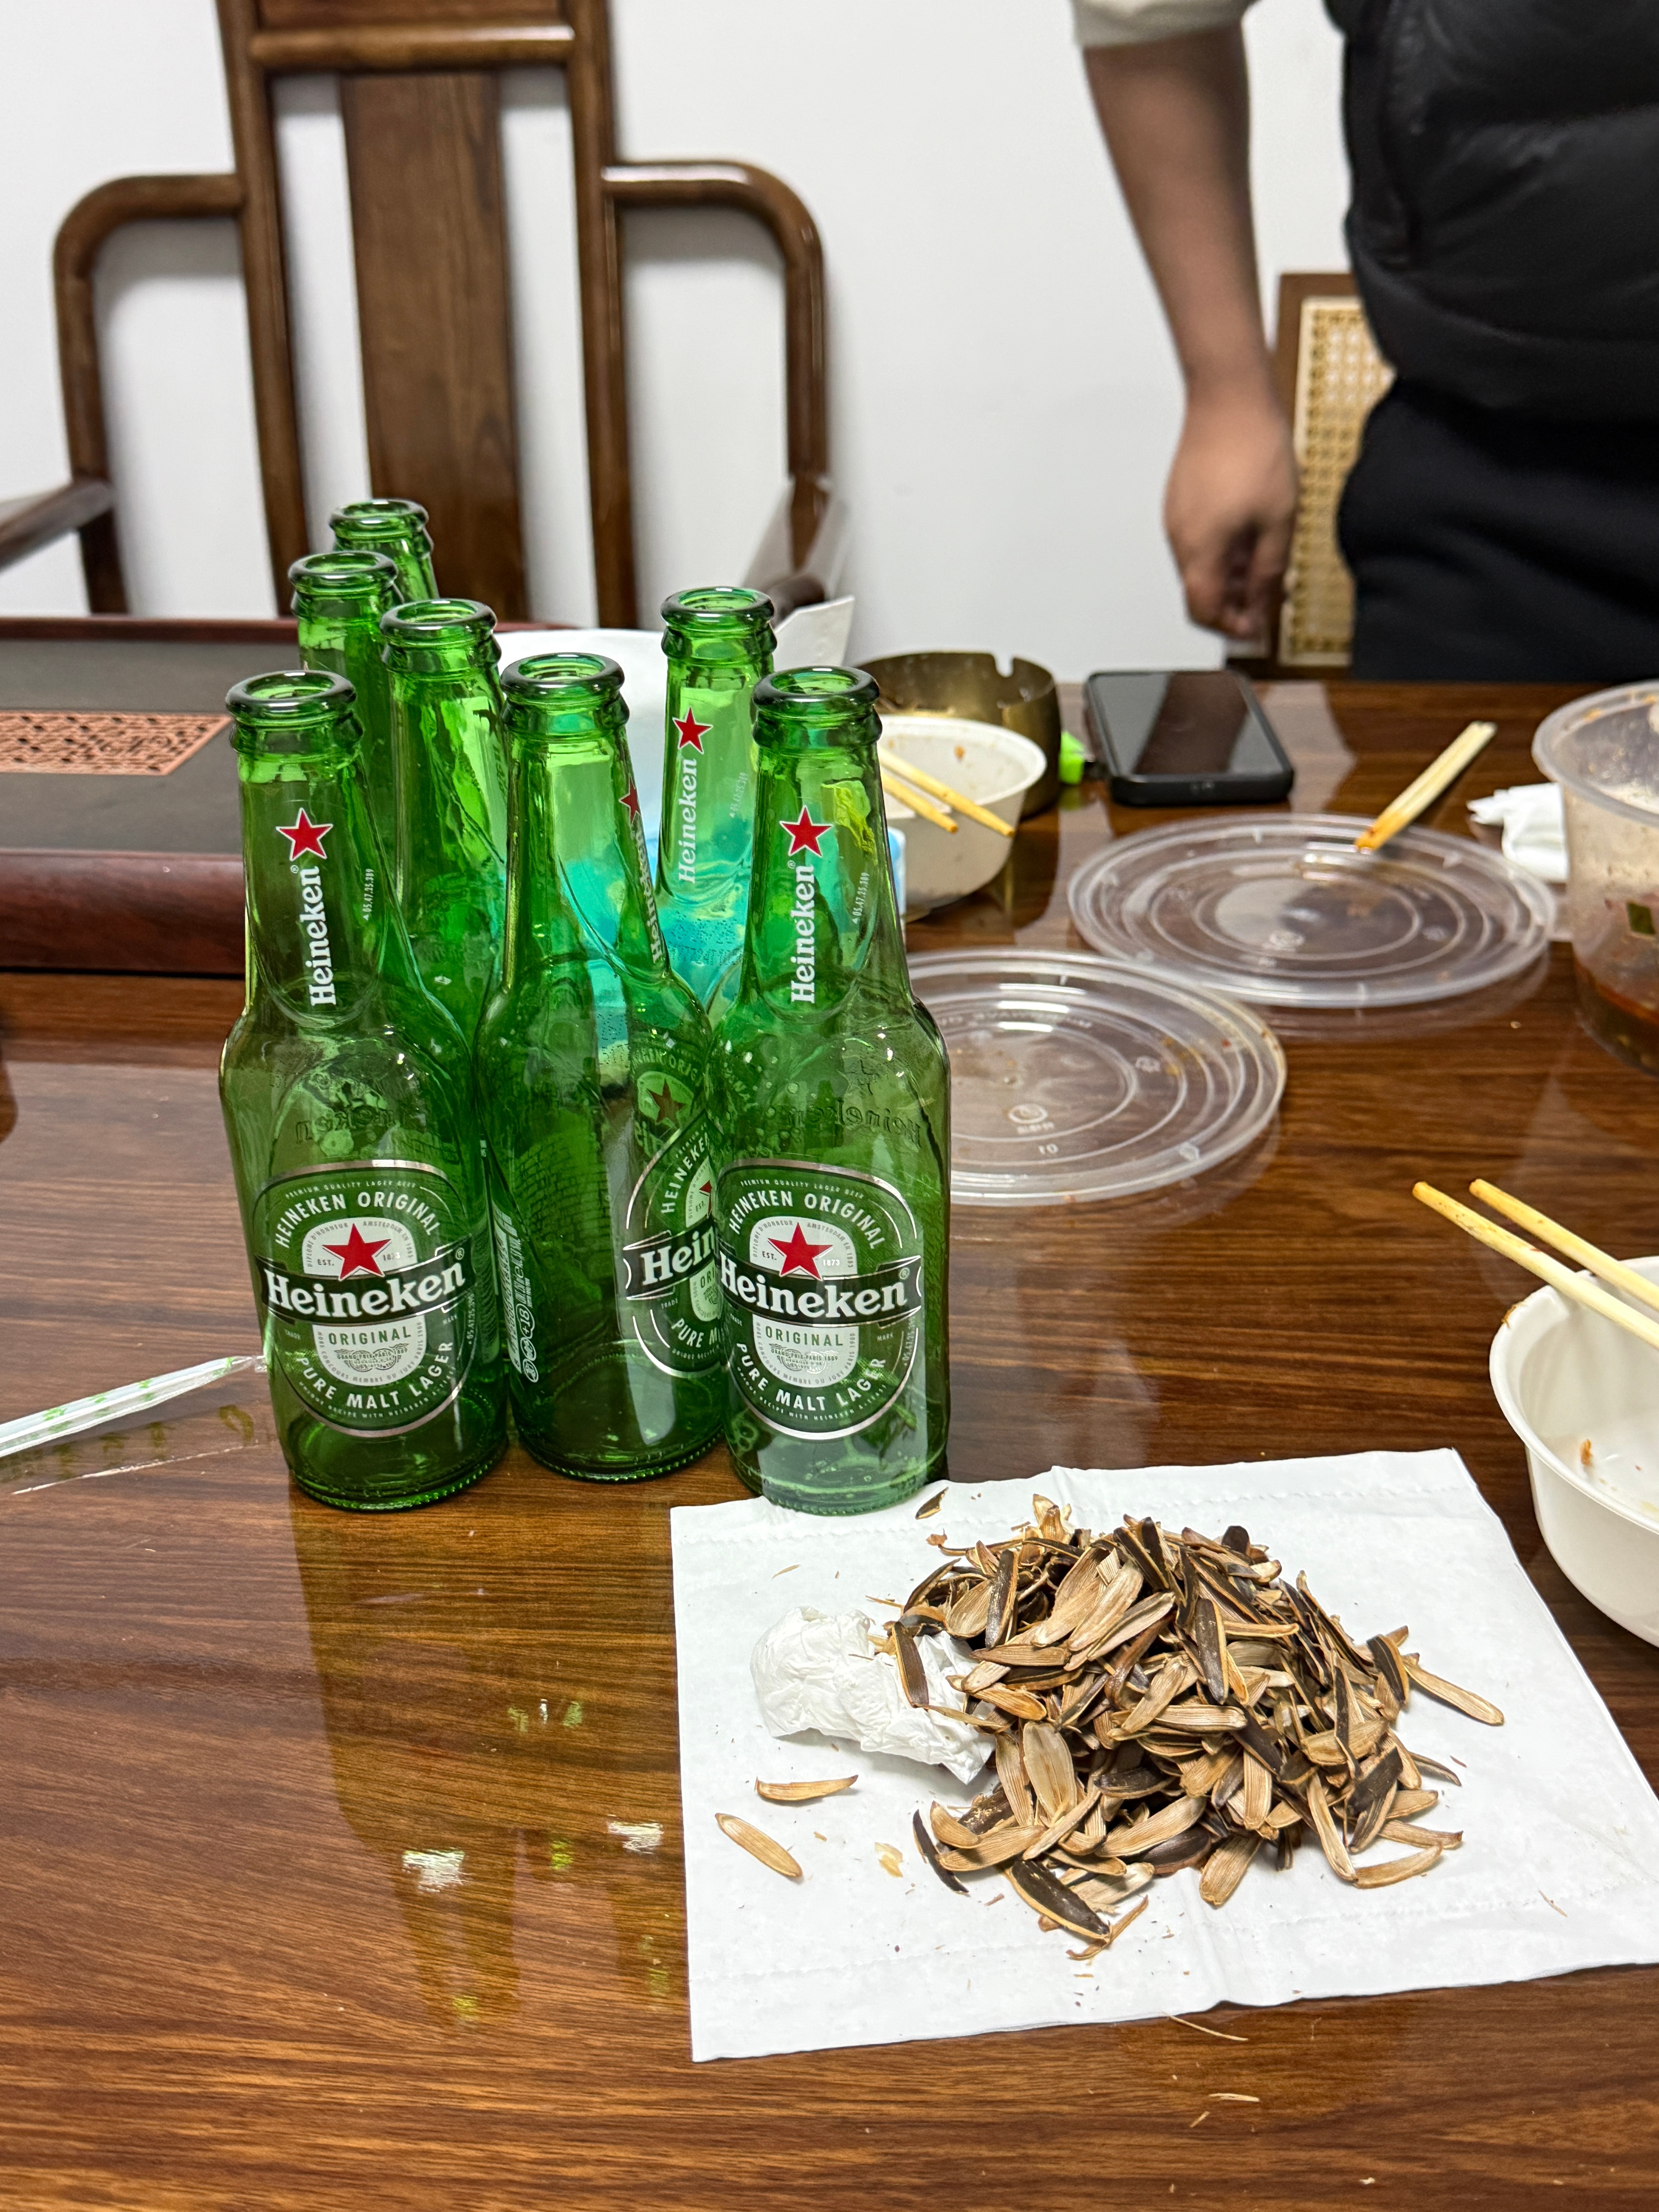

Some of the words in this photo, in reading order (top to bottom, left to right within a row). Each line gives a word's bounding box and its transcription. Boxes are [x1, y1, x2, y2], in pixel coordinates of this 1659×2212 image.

[678, 759, 697, 884] Heineken
[299, 865, 336, 1006] Heineken
[791, 864, 815, 1004] Heineken
[814, 1183, 840, 1192] LAGER
[275, 1194, 346, 1248] HEINEKEN
[358, 1192, 441, 1236] ORIGINAL
[729, 1190, 793, 1235] HEINEKEN
[804, 1193, 885, 1249] ORIGINAL
[807, 1223, 845, 1241] AMSTERDAM
[641, 1229, 715, 1285] Hein
[719, 1250, 907, 1317] Heineken
[762, 1251, 777, 1260] EST.
[264, 1263, 465, 1317] Heineken
[328, 1326, 411, 1345] ORIGINAL
[671, 1318, 704, 1348] PURE
[766, 1326, 843, 1346] ORIGINAL
[877, 1332, 893, 1343] MARK
[297, 1357, 337, 1400] PURE
[347, 1391, 399, 1409] MALT
[410, 1341, 453, 1395] LAGER
[737, 1343, 768, 1392] PURE
[776, 1389, 824, 1411] MALT
[836, 1358, 886, 1407] LAGER
